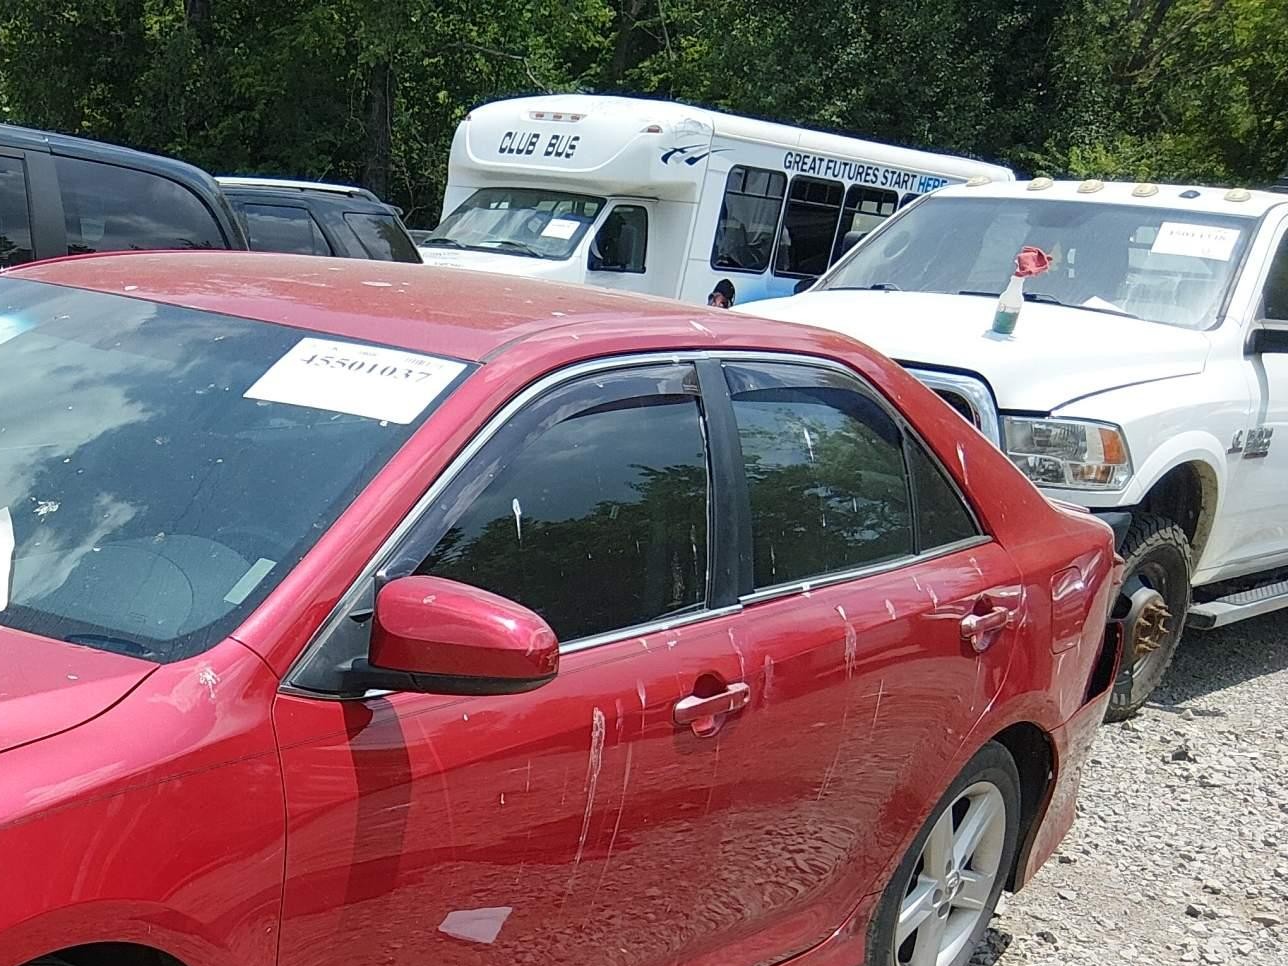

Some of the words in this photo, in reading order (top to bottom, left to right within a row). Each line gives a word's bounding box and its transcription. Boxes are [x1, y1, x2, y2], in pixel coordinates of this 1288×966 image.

[499, 131, 541, 155] CLUB
[544, 134, 580, 159] BUS
[783, 151, 825, 175] GREAT
[825, 159, 880, 185] FUTURES
[880, 168, 917, 191] START
[300, 353, 433, 383] 45501037
